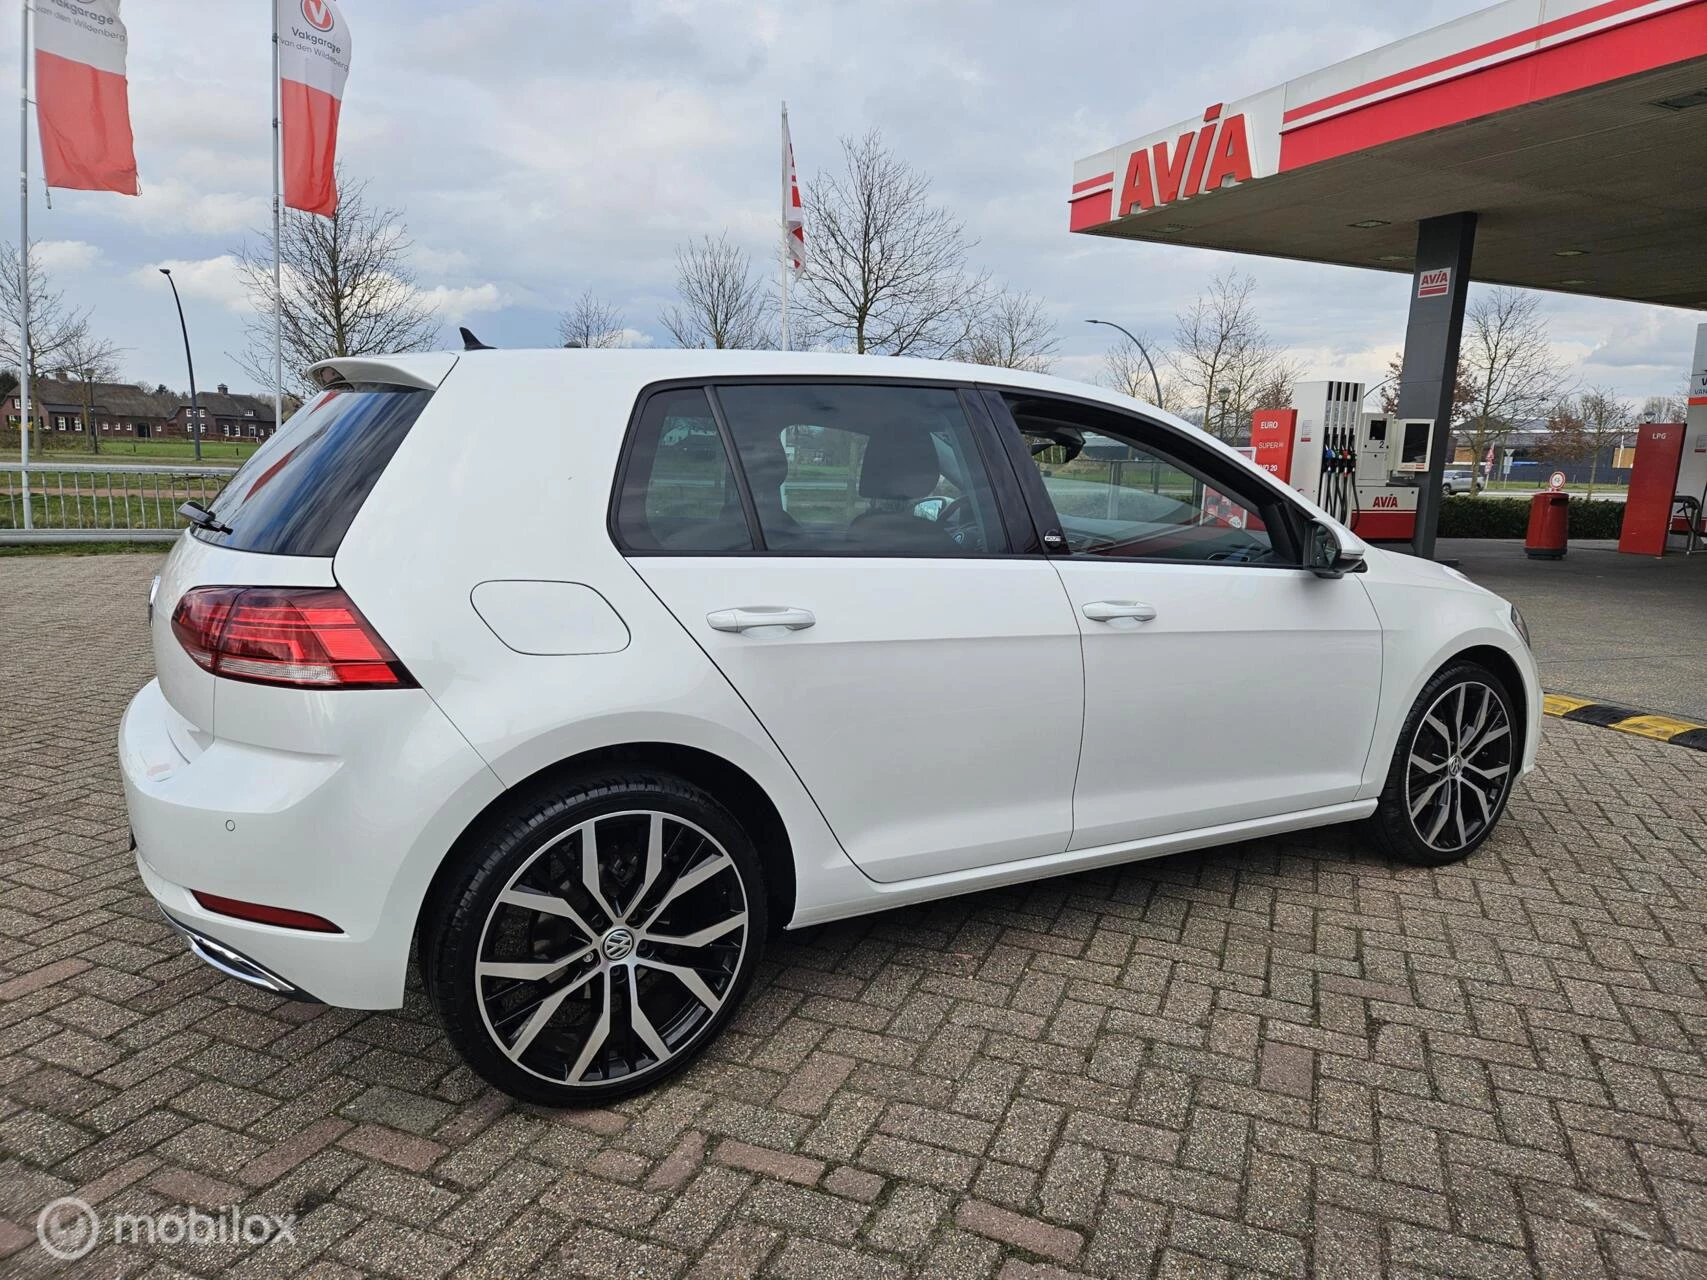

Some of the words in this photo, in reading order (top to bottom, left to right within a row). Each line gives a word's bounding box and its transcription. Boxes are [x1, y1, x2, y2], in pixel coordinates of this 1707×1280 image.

[51, 0, 114, 25] akgarage
[36, 5, 53, 16] van
[54, 12, 72, 24] den
[73, 18, 126, 42] Wildenberg
[280, 39, 295, 47] van
[296, 43, 312, 53] den
[1260, 421, 1279, 429] EURO
